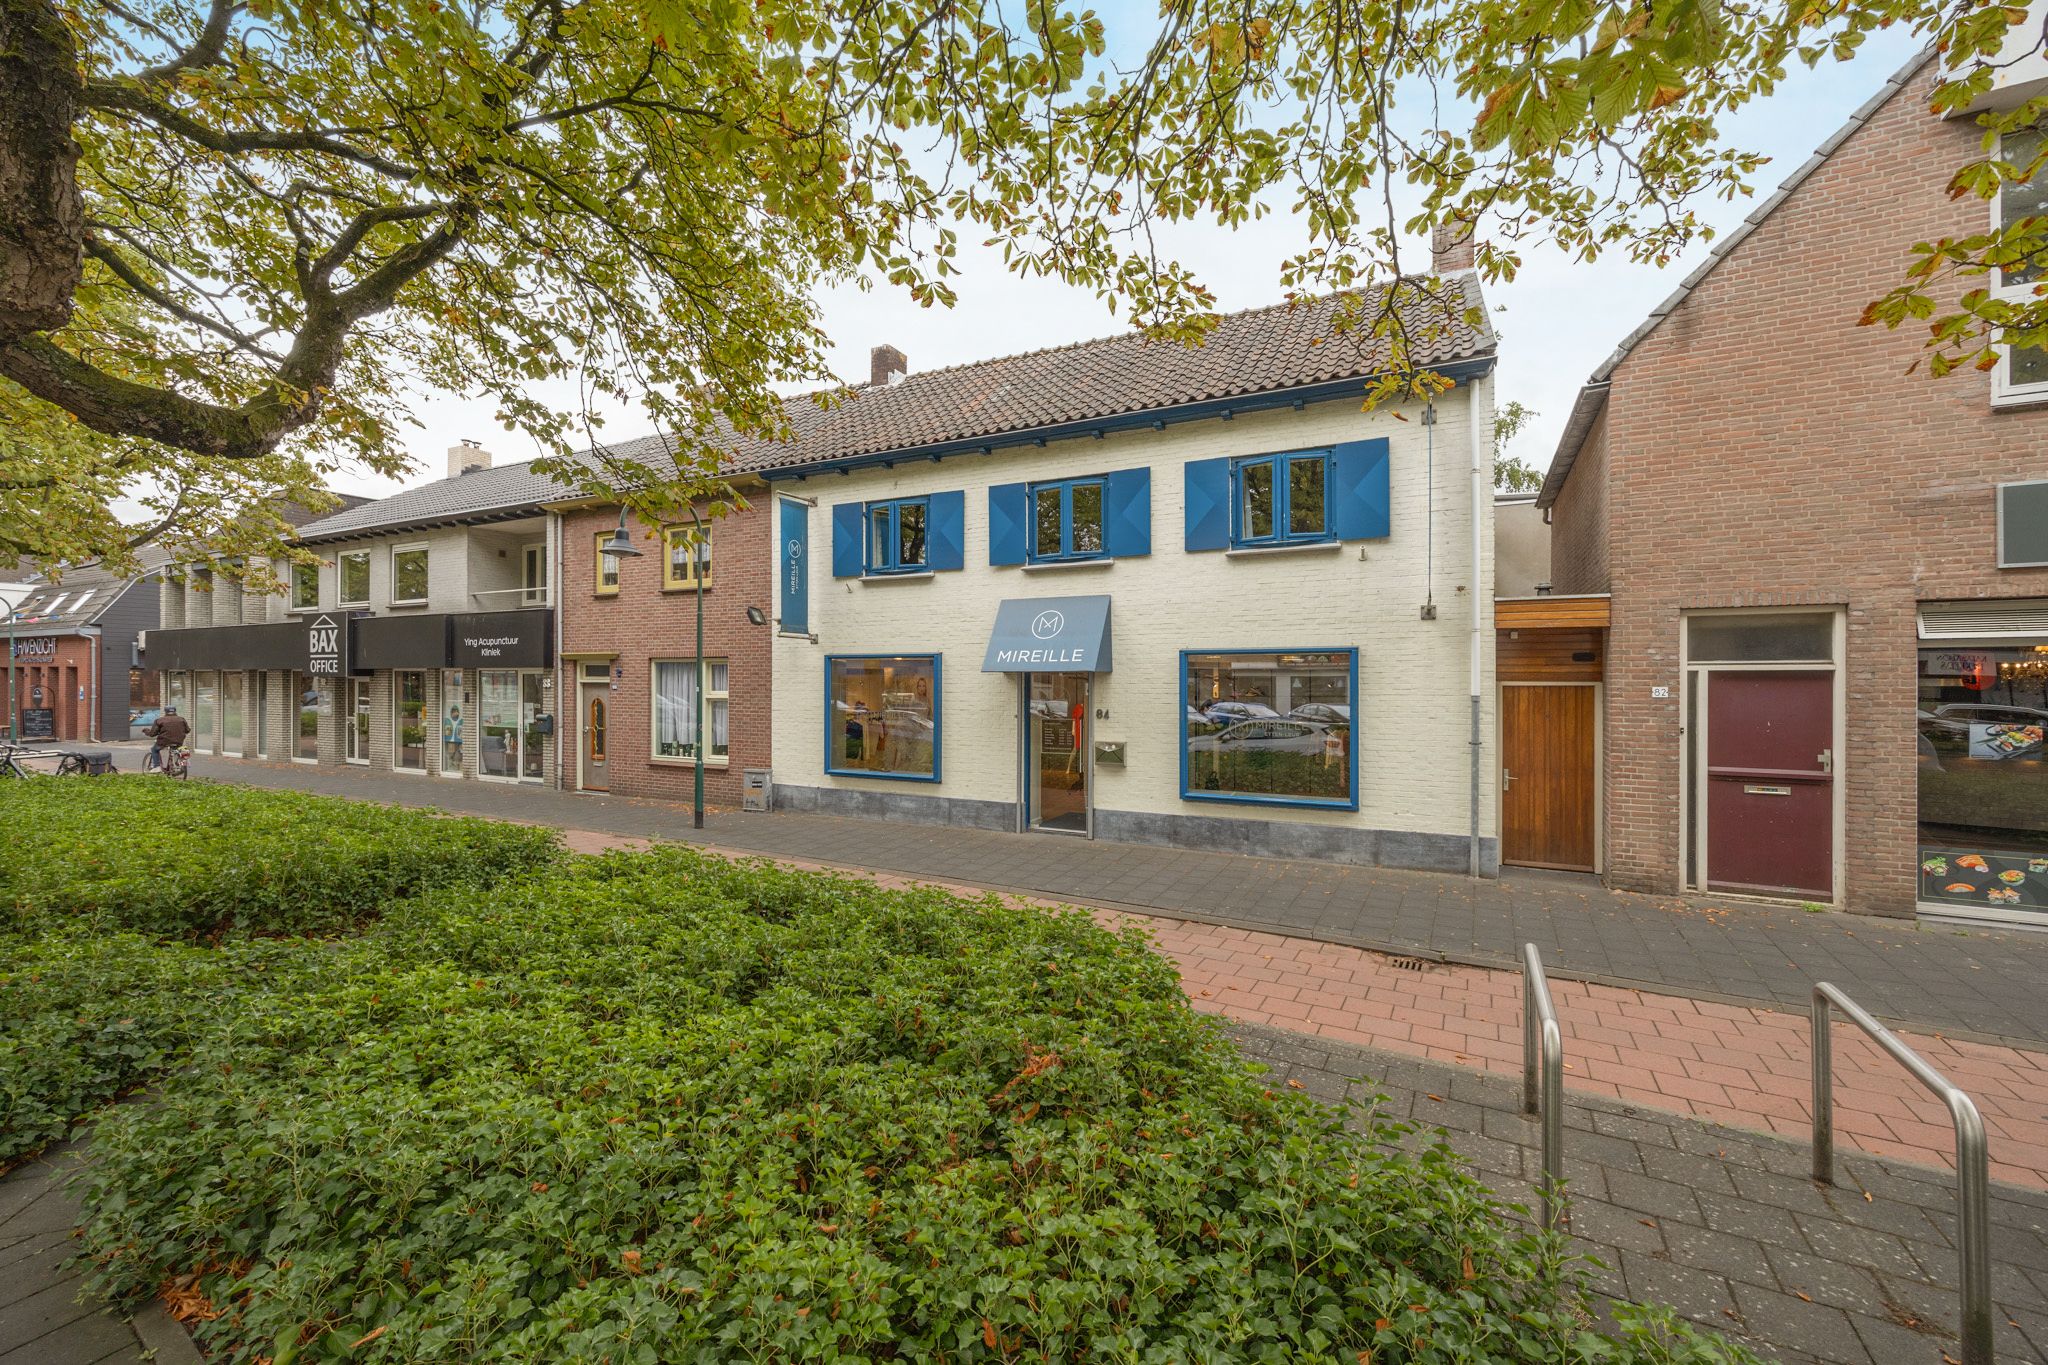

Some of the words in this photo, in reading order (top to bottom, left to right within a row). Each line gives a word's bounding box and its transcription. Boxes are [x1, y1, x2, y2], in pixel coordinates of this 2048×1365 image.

[17, 638, 56, 654] HAVENZICHT
[309, 630, 338, 653] BAX
[464, 637, 478, 648] Ying
[478, 637, 519, 647] Acupunctuur
[481, 647, 501, 657] Kliniek
[997, 649, 1085, 663] MIREILLE
[310, 659, 338, 673] OFFICE
[1654, 688, 1666, 696] 82
[1096, 709, 1110, 720] 84
[1255, 721, 1309, 731] MIREILLE
